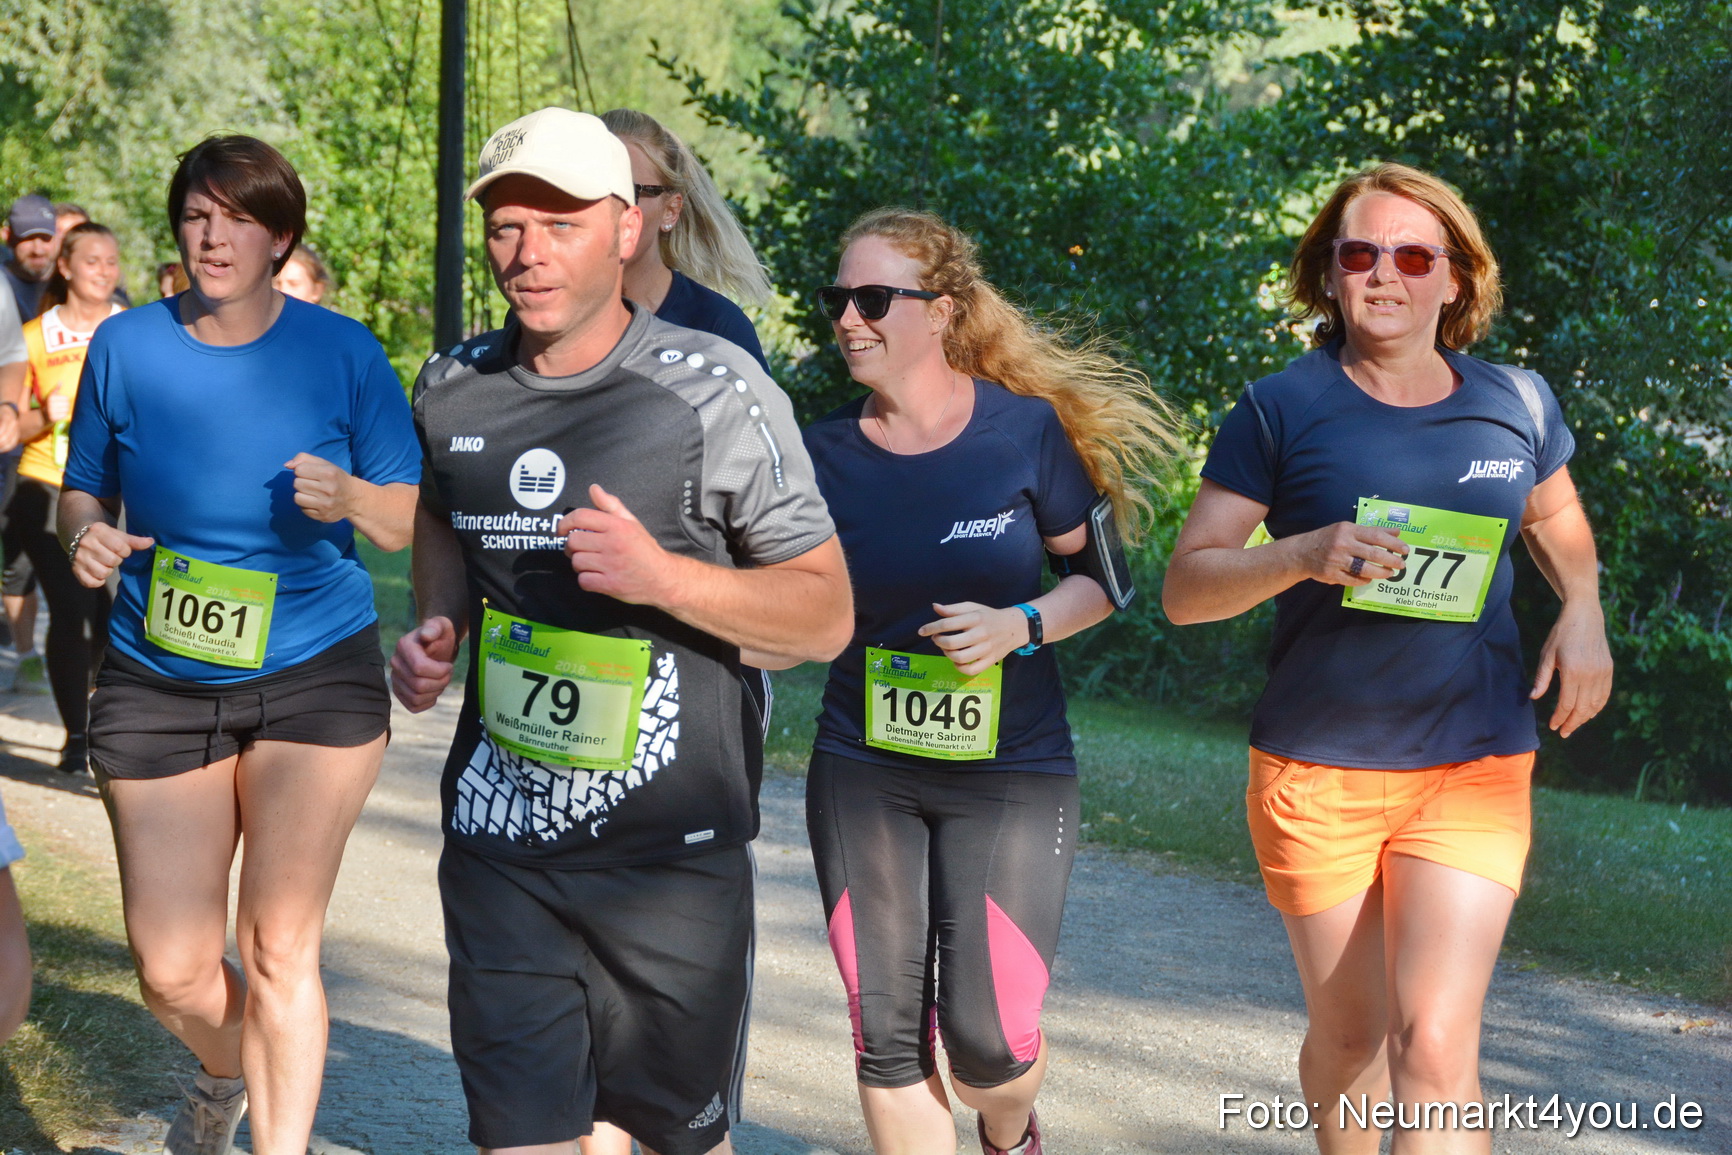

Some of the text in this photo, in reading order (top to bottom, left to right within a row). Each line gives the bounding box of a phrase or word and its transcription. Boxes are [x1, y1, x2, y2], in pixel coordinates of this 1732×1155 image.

[494, 131, 527, 154] ROCK
[450, 437, 484, 452] JAKO
[1458, 460, 1510, 483] JURA
[940, 517, 998, 544] JURA
[1376, 517, 1428, 535] firmenlauf
[481, 535, 569, 551] SCHOTTERWE
[1377, 583, 1459, 603] Strobl Christian
[1395, 597, 1438, 609] Klebl GmbH
[161, 587, 248, 639] 1061
[159, 632, 191, 647] Lebenshilfe
[192, 642, 225, 655] Neumarkt
[164, 623, 236, 649] Schießl Claudia
[500, 635, 552, 658] firmenlauf
[882, 665, 928, 680] firmenlauf
[522, 670, 581, 726] 79
[882, 687, 982, 731] 1046
[496, 711, 607, 746] Weißmüller Rainer
[885, 723, 977, 742] Dietmayer Sabrina
[518, 733, 569, 752] Bärnreuther
[887, 734, 925, 747] Lebenshilfe
[925, 739, 960, 750] Neumarkt
[961, 743, 974, 751] e.V.
